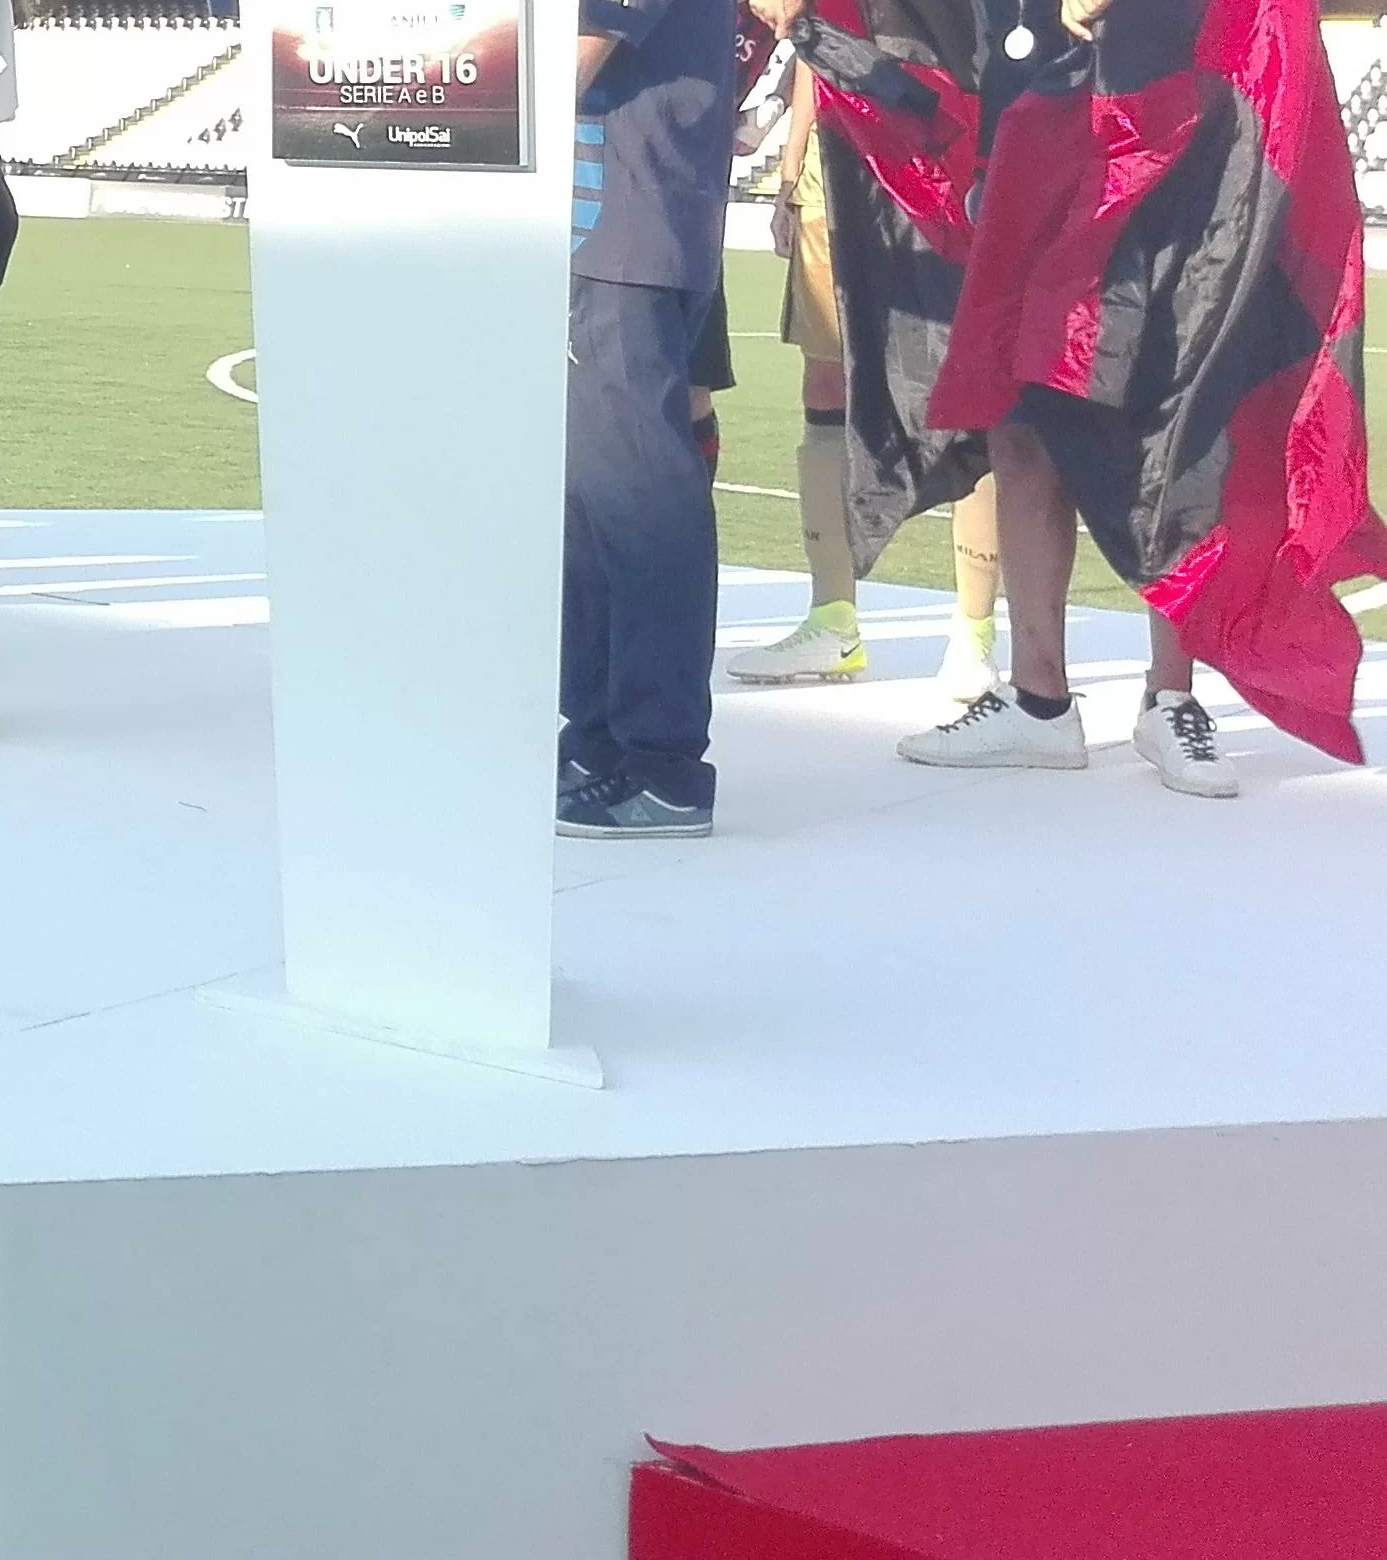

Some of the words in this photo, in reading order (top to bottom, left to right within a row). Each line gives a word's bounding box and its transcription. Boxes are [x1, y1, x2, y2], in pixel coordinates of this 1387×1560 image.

[308, 53, 426, 85] UNDER
[433, 52, 478, 86] 16
[339, 85, 394, 104] SERIE
[398, 85, 413, 104] A
[414, 89, 429, 105] e
[431, 85, 446, 104] B
[387, 125, 451, 147] UnipolSai
